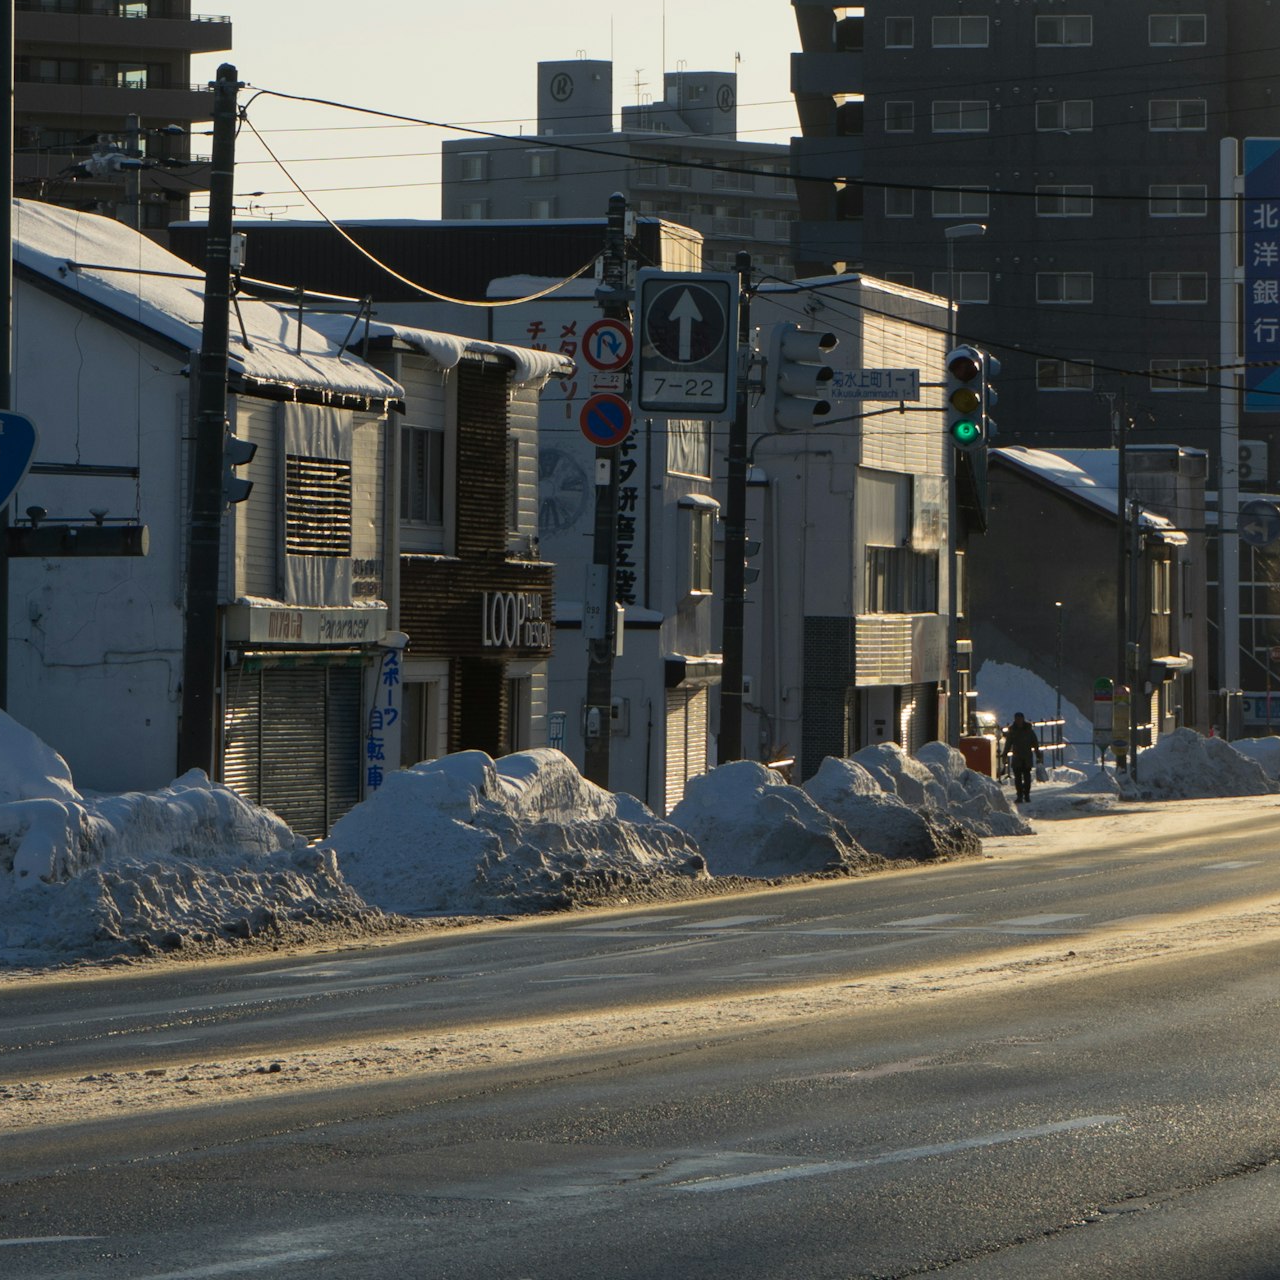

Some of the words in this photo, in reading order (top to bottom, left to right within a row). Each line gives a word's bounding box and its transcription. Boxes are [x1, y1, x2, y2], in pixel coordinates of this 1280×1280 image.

[1253, 203, 1279, 343] 北洋銀行
[482, 591, 525, 648] LOOP
[525, 621, 551, 648] DESIGN
[383, 649, 399, 726] スポーツ
[367, 709, 384, 790] 自転車
